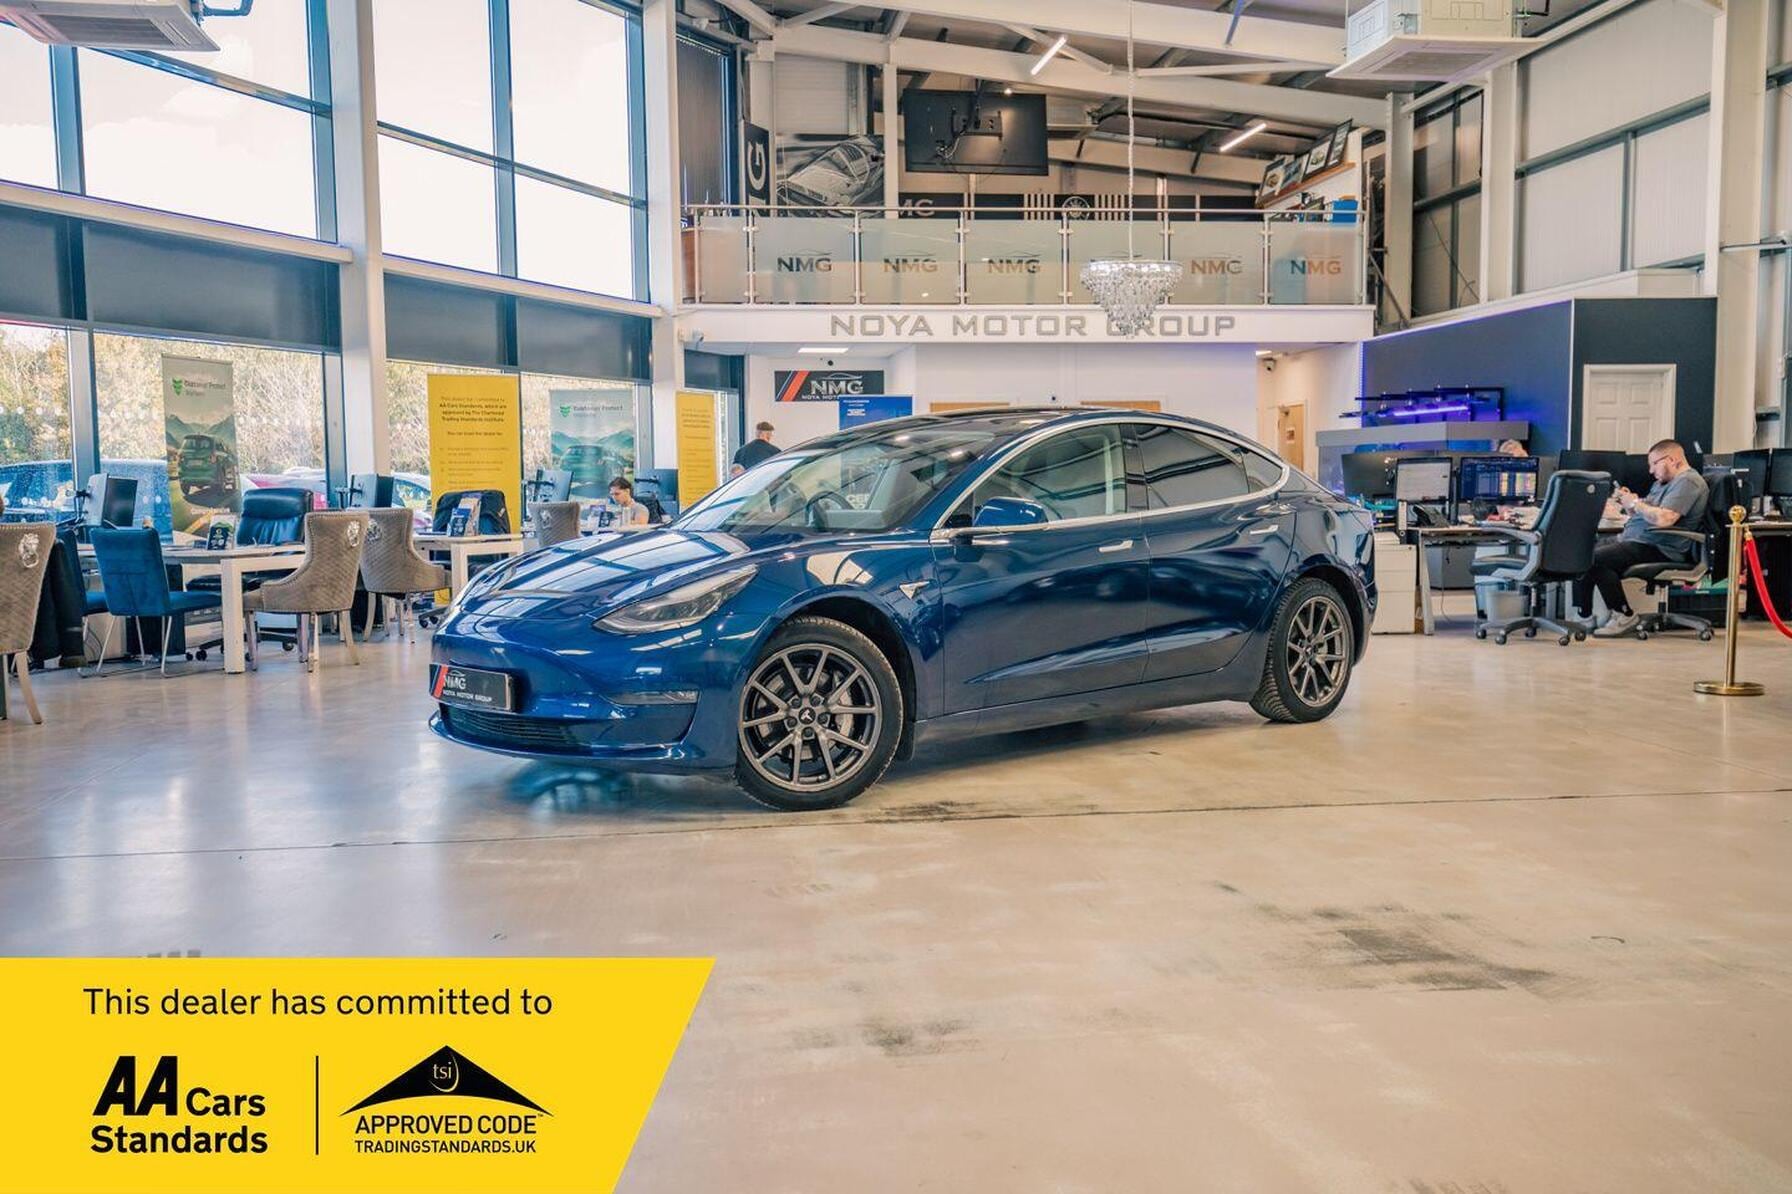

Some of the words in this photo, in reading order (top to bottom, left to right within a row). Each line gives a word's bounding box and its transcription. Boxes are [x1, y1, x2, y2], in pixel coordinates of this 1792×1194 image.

[777, 256, 833, 273] NMG
[883, 257, 939, 274] NMG
[987, 257, 1042, 275] NMG
[1190, 258, 1243, 275] NMG
[1290, 258, 1342, 275] NMG
[829, 315, 934, 337] NOYA
[952, 314, 1087, 337] MOTOR
[810, 379, 864, 395] NMG
[443, 675, 466, 689] NMG
